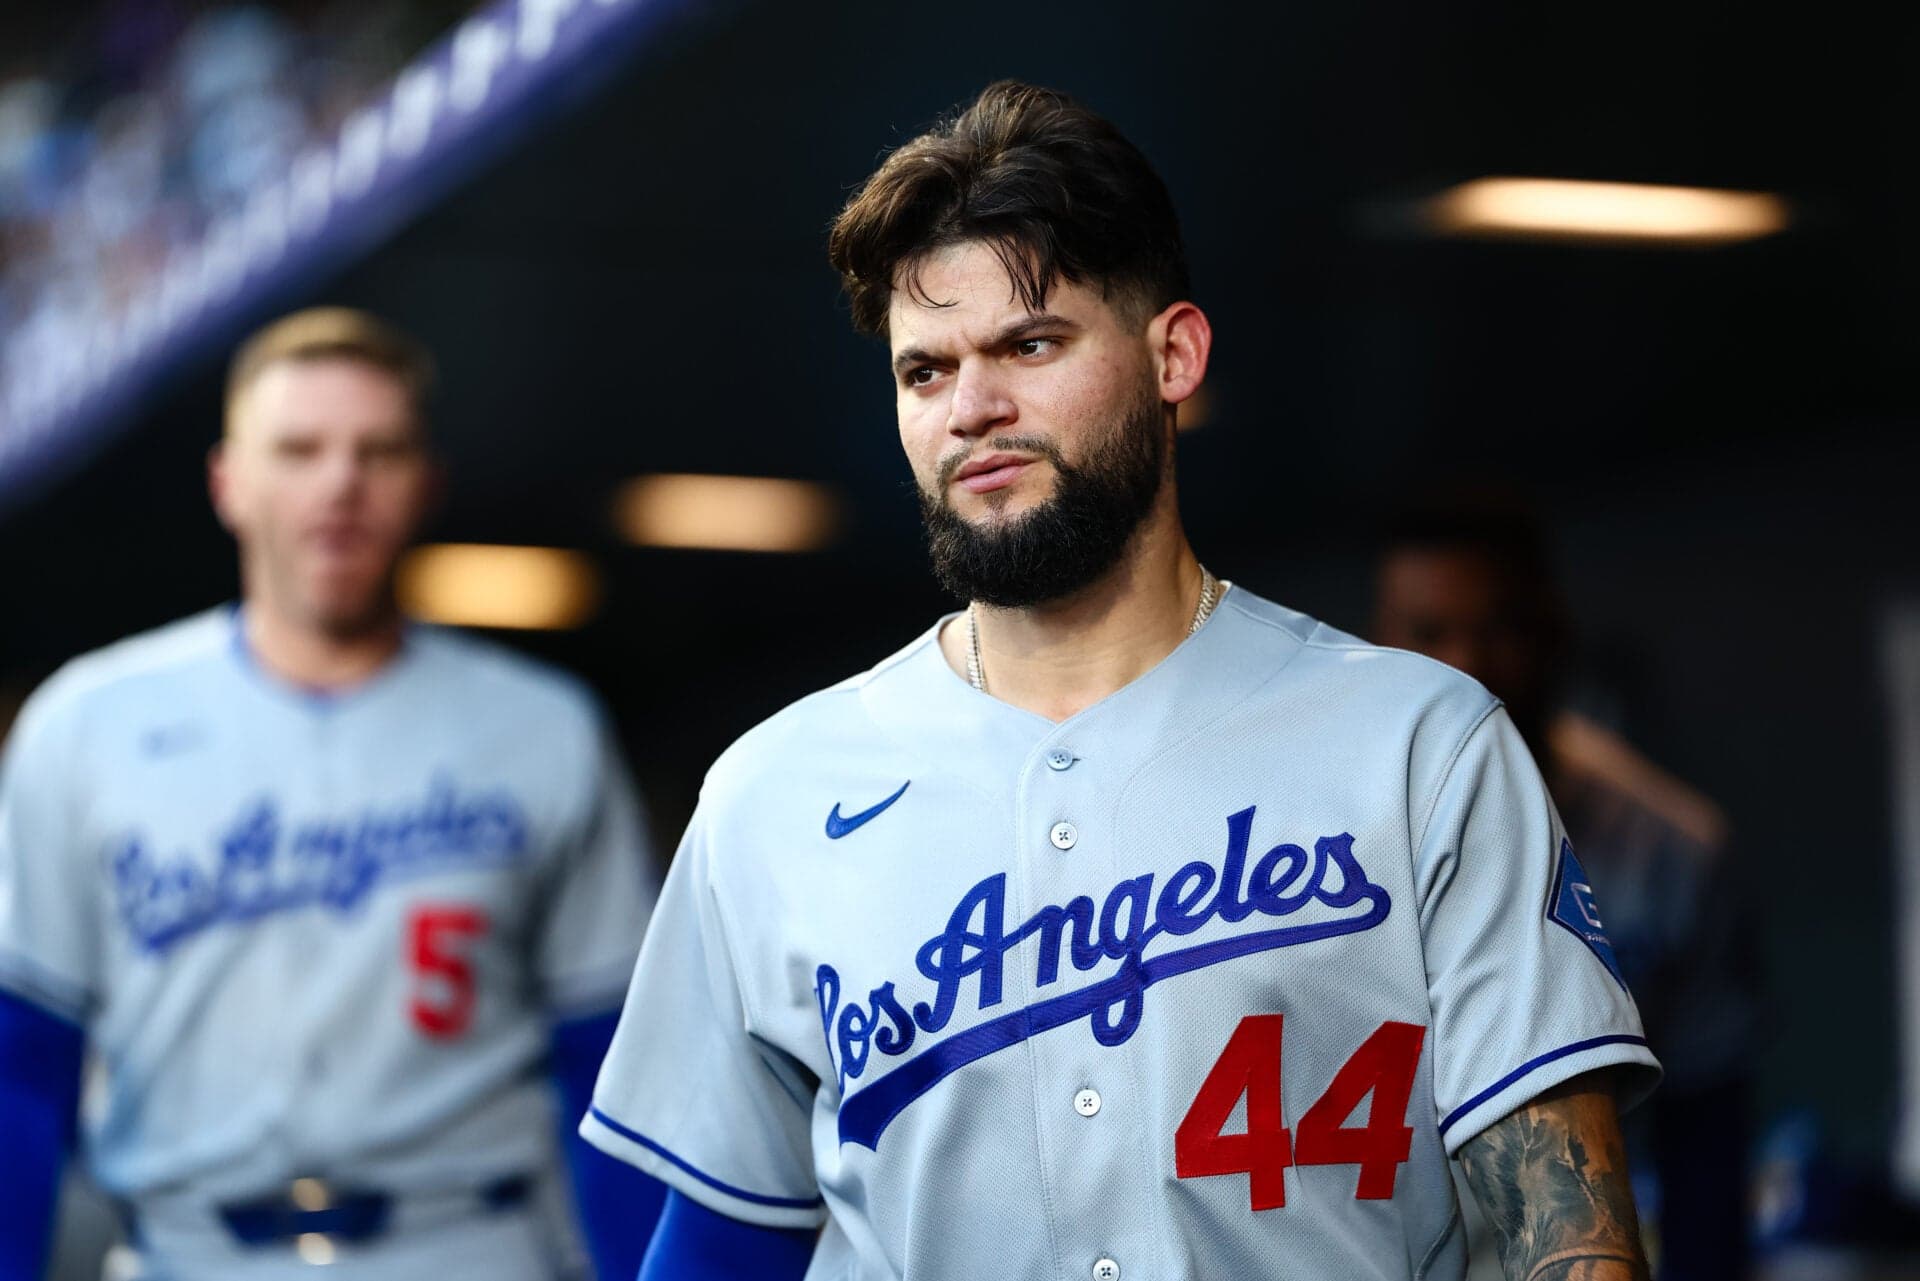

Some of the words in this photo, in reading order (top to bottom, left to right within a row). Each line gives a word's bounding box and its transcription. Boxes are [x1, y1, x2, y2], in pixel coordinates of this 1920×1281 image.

[409, 902, 489, 1041] 5
[814, 964, 916, 1096] Los
[914, 805, 1391, 1046] Angeles
[1175, 1013, 1427, 1211] 44
